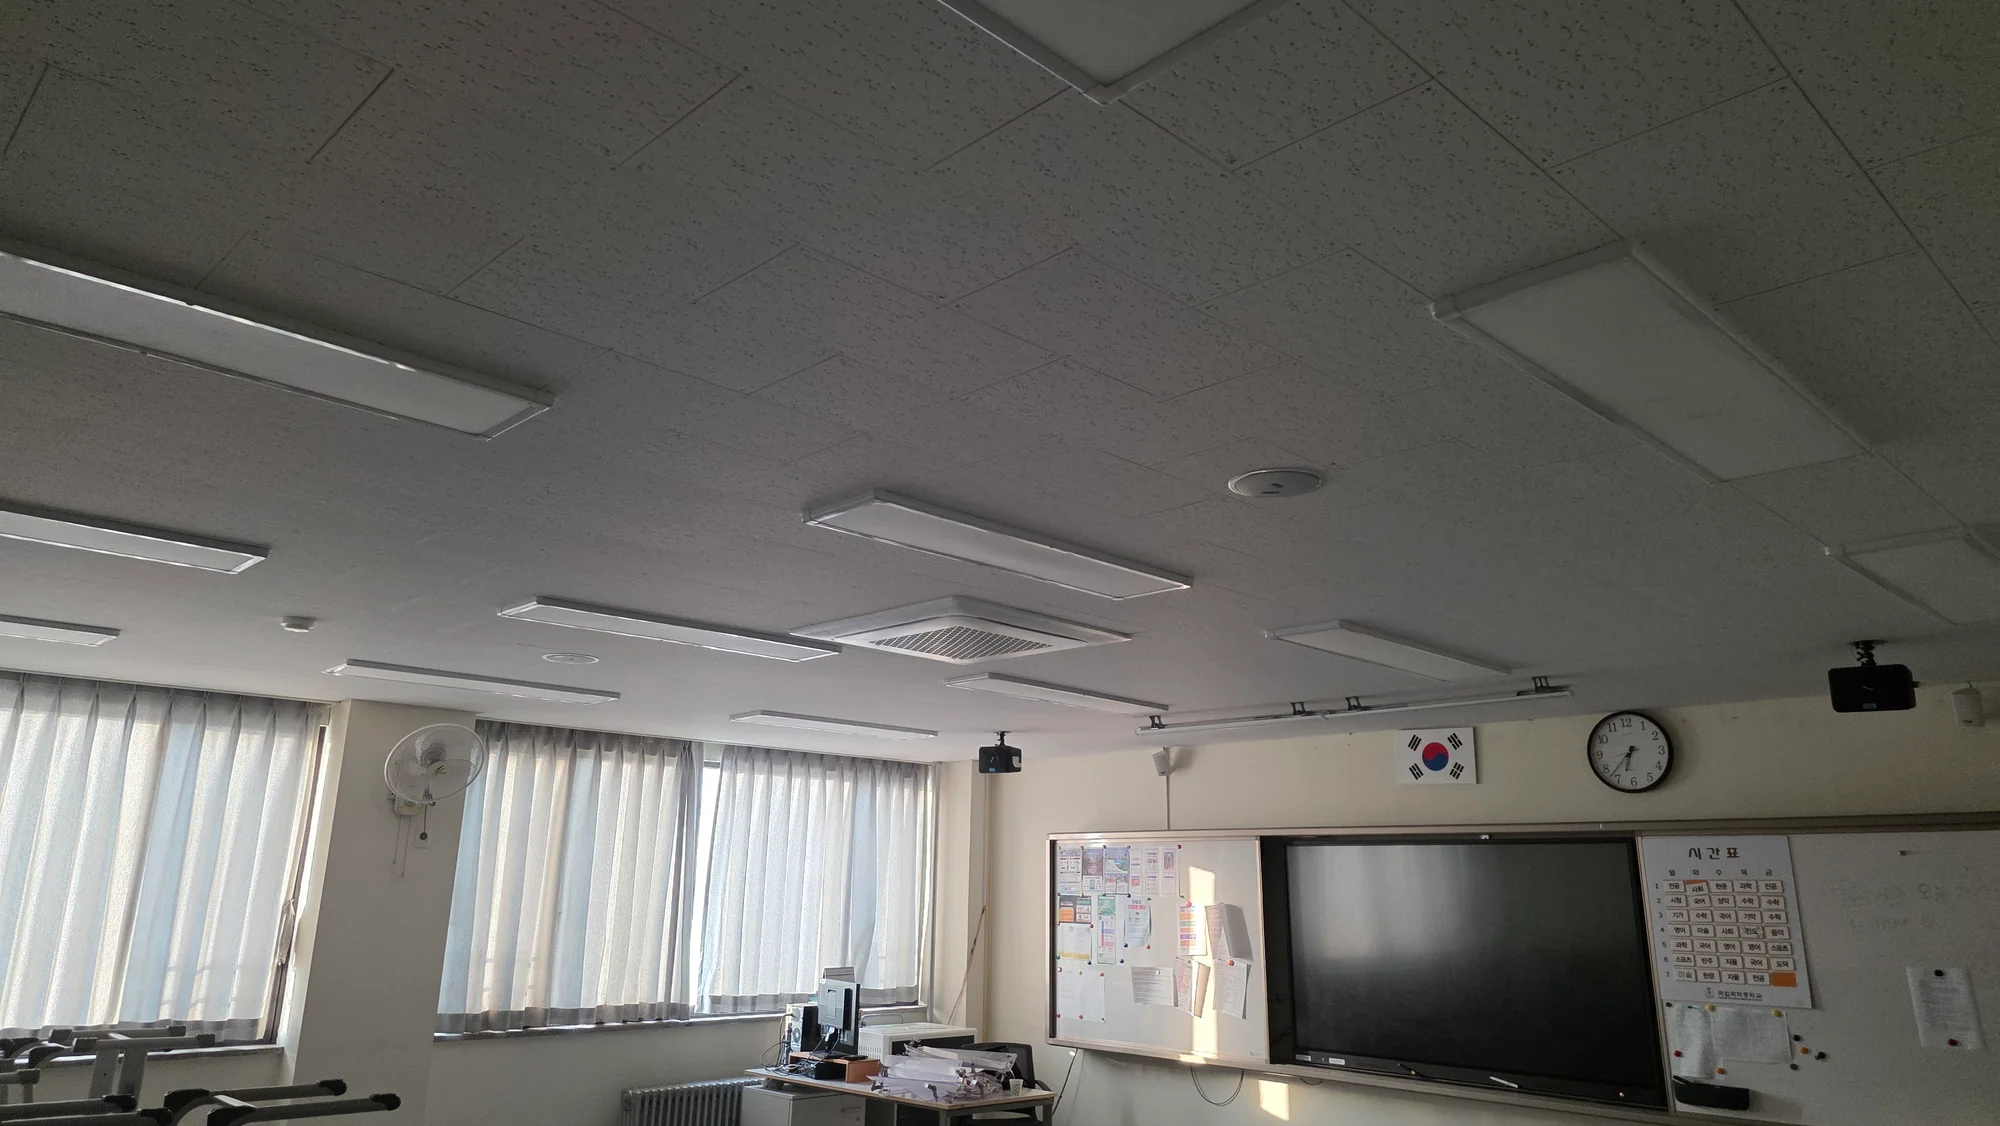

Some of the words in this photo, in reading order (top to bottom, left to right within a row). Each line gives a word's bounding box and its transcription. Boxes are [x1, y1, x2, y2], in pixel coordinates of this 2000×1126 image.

[1608, 722, 1617, 732] 11
[1621, 718, 1632, 728] 12
[1641, 721, 1646, 730] 1
[1599, 734, 1608, 744] 10
[1652, 731, 1659, 740] 2
[1597, 750, 1603, 759] 9
[1658, 745, 1665, 755] 3
[1603, 764, 1610, 773] 8
[1655, 761, 1662, 770] 4
[1615, 775, 1621, 784] 7
[1630, 777, 1637, 786] 6
[1647, 773, 1653, 782] 5
[1688, 847, 1740, 859] 시간표
[1742, 897, 1754, 905] 수학
[1722, 927, 1734, 935] 사회
[1751, 958, 1763, 966] 국어
[1776, 960, 1789, 968] 도덕
